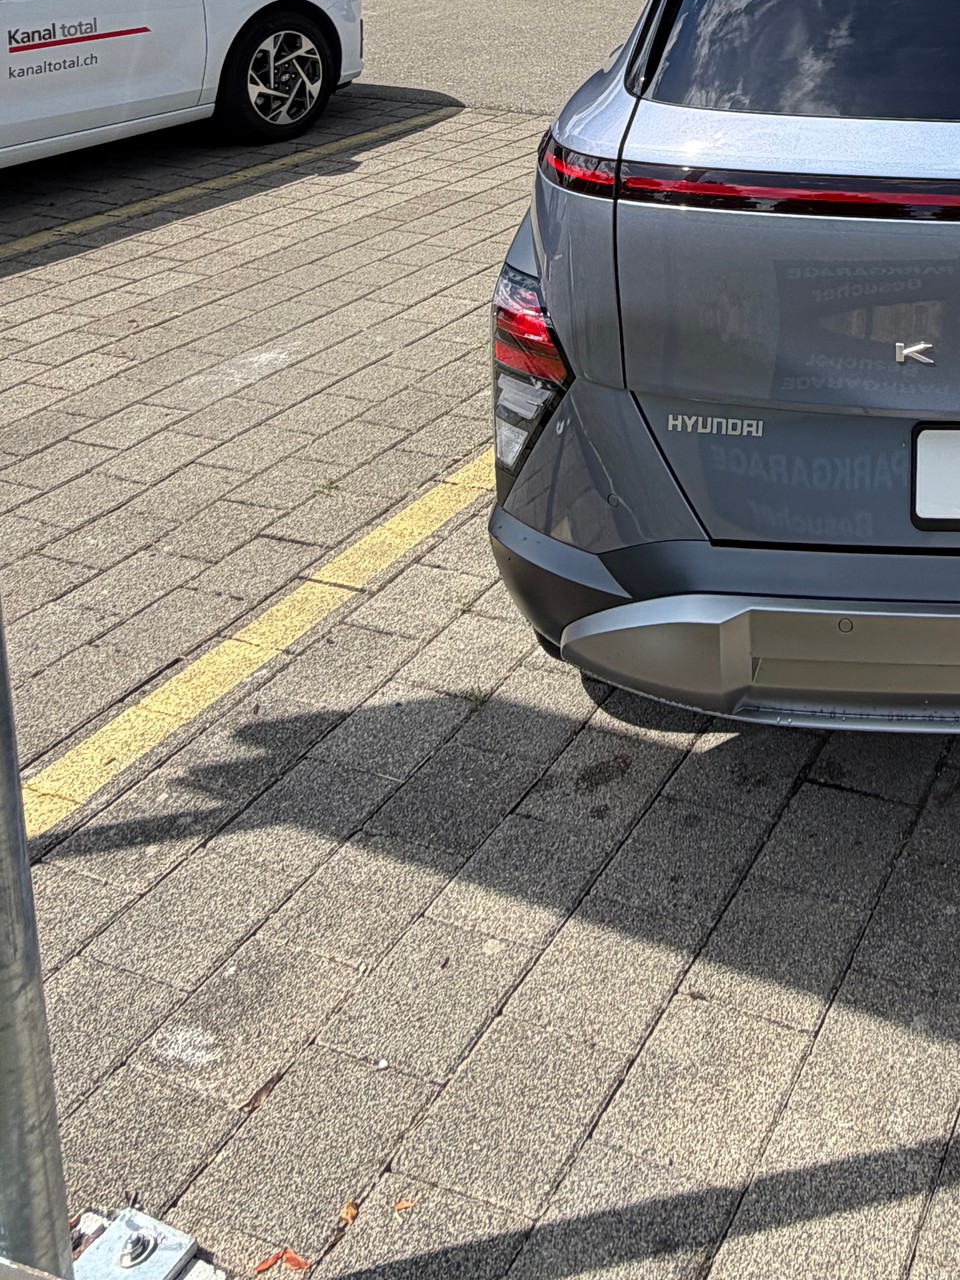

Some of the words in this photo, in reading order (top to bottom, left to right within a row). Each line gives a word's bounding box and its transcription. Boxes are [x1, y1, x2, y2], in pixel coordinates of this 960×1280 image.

[7, 22, 57, 46] Kanal
[60, 17, 98, 38] total
[8, 53, 98, 79] kanaltotal.ch
[667, 414, 764, 437] HYUNDAI
